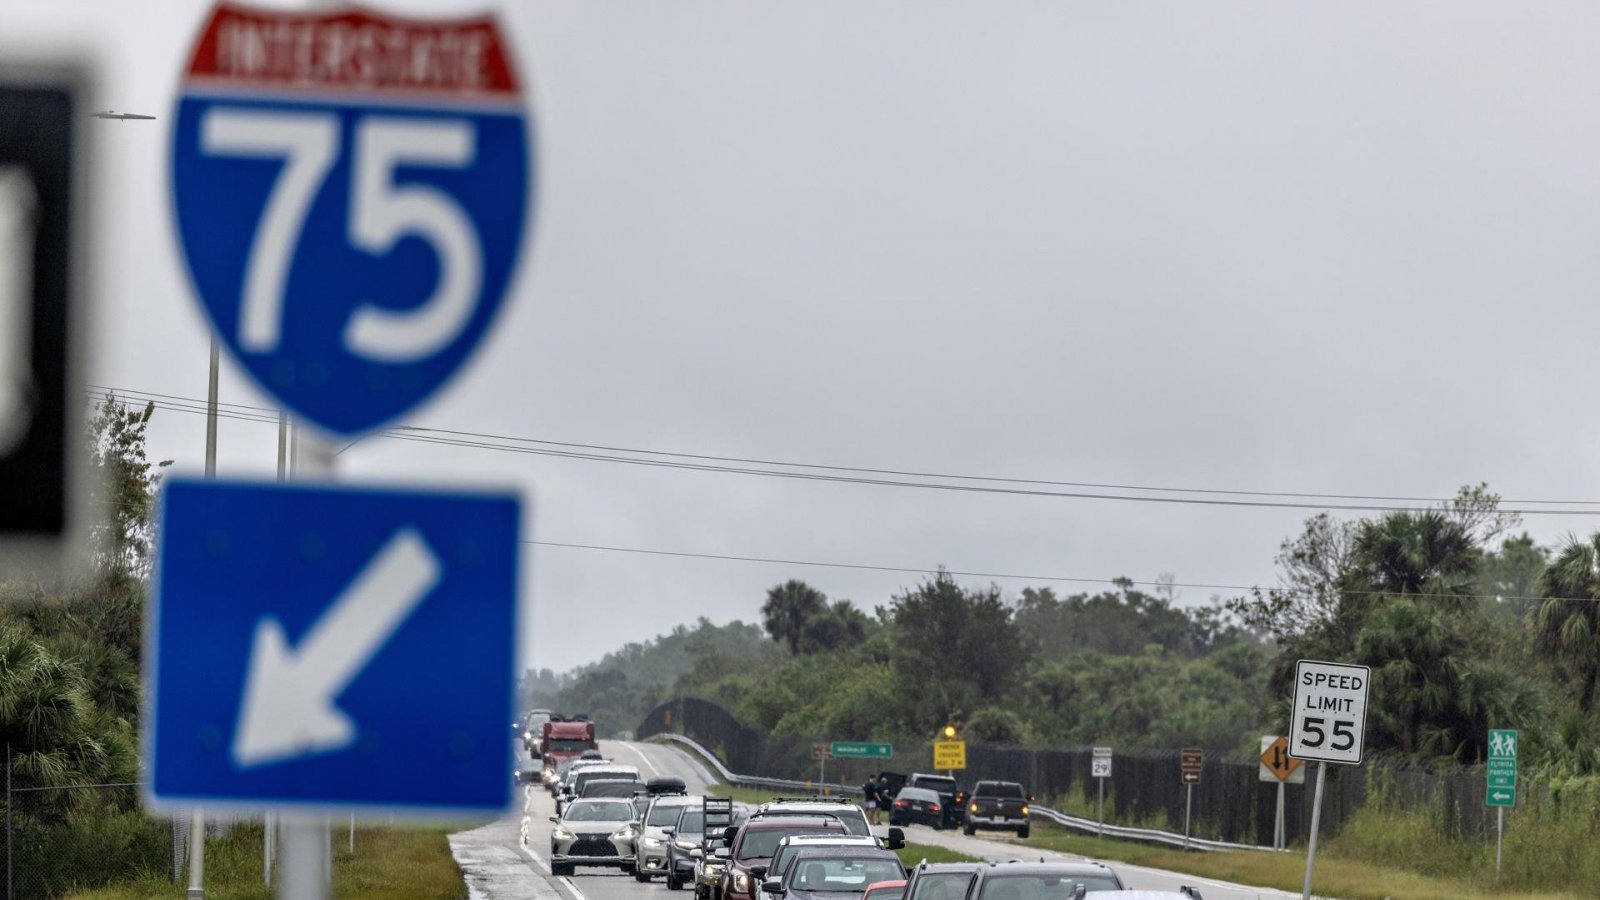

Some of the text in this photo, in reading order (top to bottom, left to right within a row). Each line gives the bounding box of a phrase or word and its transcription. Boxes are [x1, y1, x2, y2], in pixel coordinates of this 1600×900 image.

[215, 20, 486, 91] INTERSTATE
[202, 106, 485, 363] 75
[1302, 672, 1363, 691] SPEED
[1306, 695, 1355, 712] LIMIT
[1301, 717, 1355, 751] 55
[1094, 763, 1108, 774] 29
